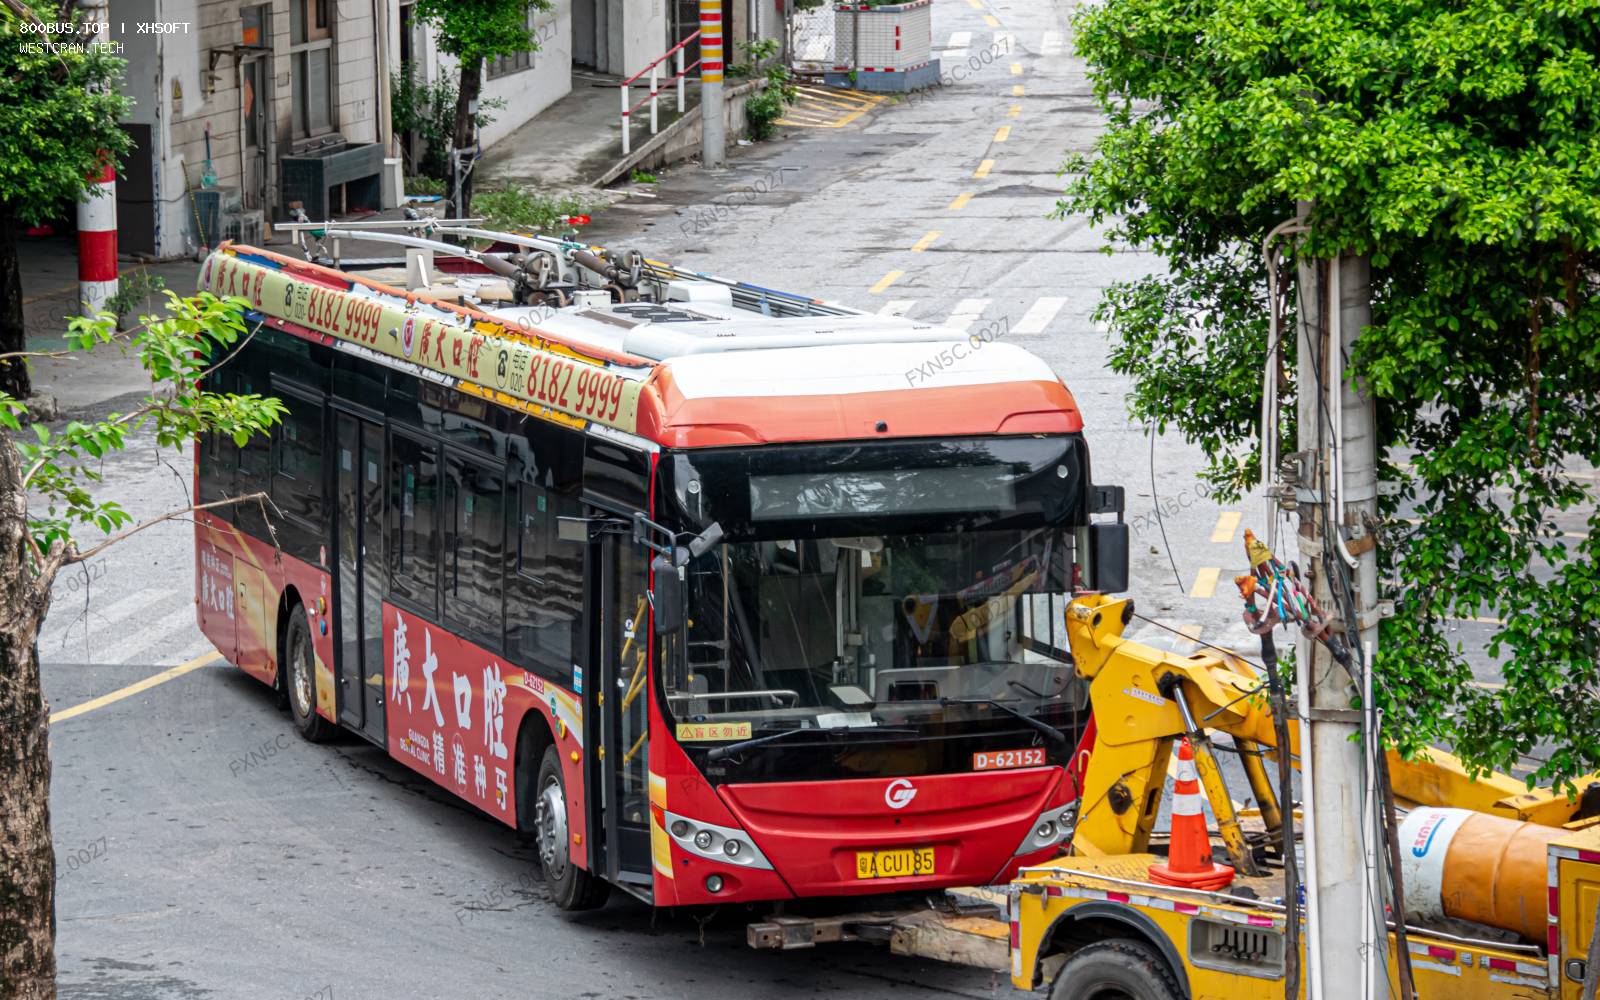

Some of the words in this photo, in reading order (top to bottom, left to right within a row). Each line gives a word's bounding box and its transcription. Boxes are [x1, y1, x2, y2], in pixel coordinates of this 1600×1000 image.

[308, 286, 345, 333] 8182
[345, 298, 383, 345] 9999
[527, 353, 574, 409] 8182
[575, 367, 625, 423] 9999
[524, 671, 544, 693] D-62152
[694, 726, 748, 738] 盲区勿近
[976, 750, 1043, 769] D-62152
